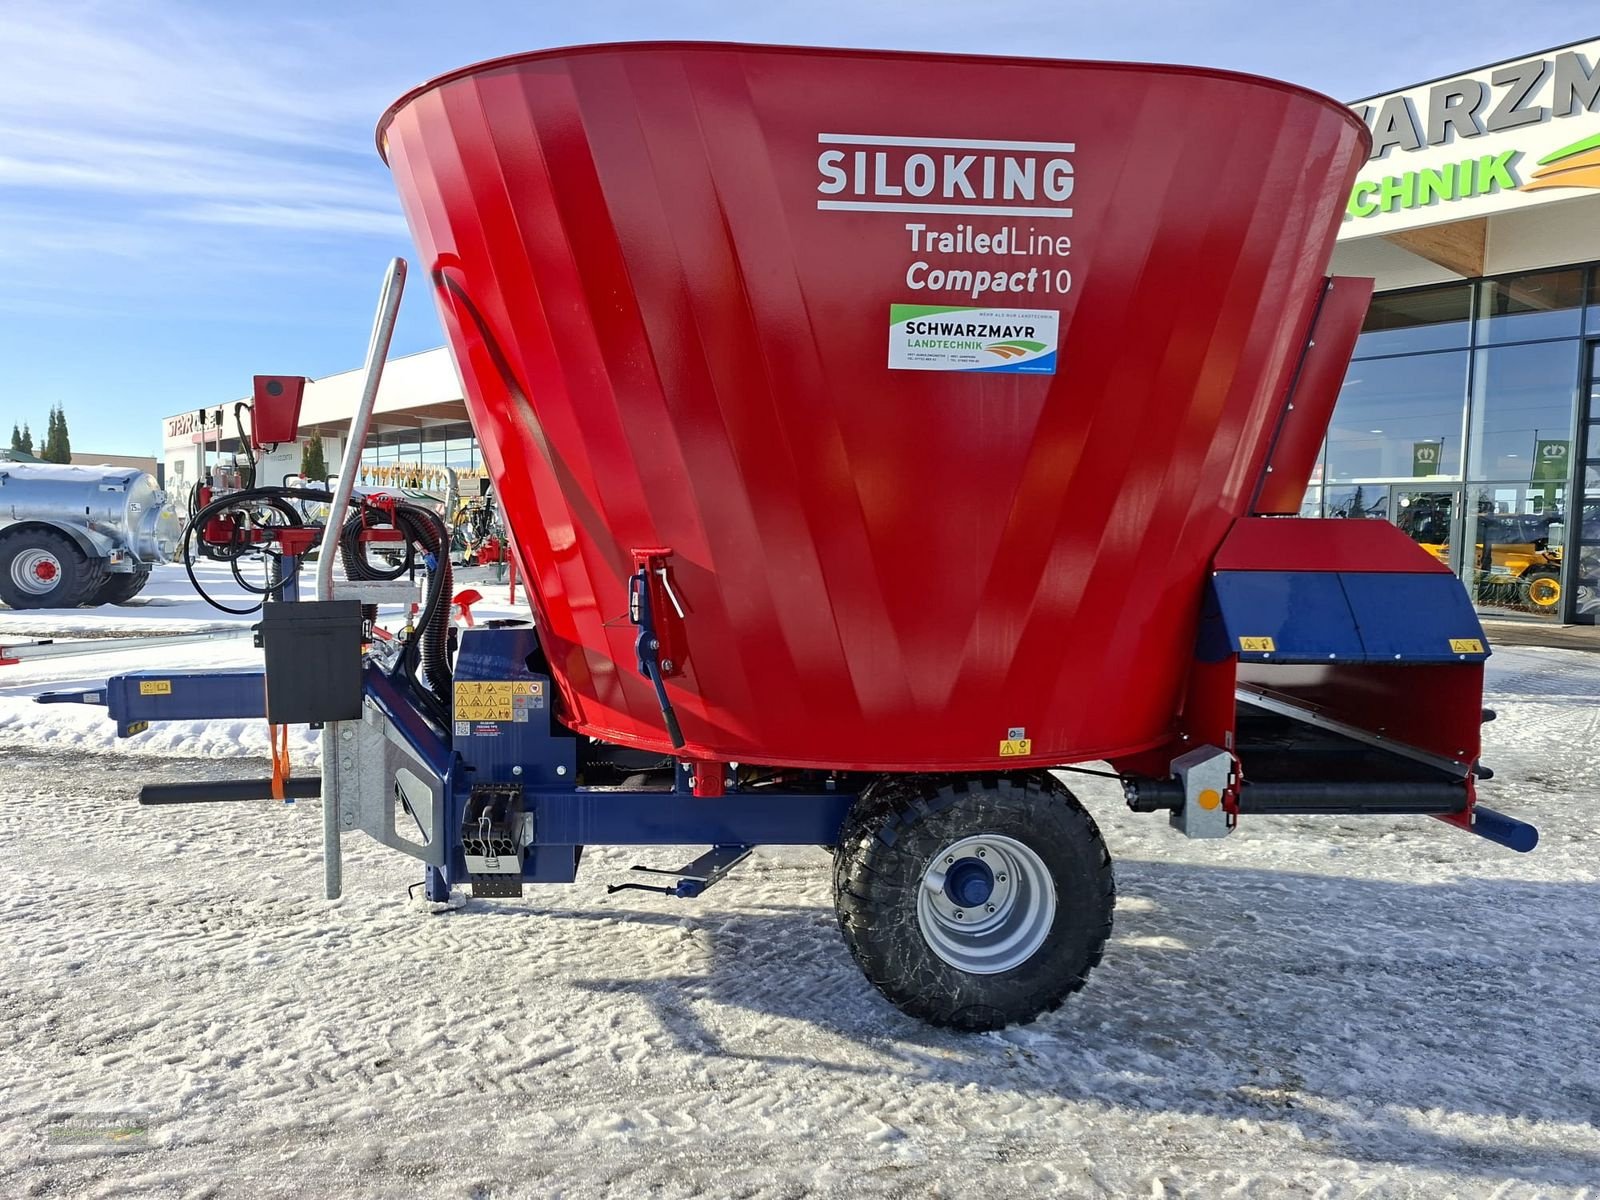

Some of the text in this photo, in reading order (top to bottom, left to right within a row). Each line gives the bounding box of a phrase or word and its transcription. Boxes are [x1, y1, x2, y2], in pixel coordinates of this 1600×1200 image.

[817, 150, 1074, 201] SILOKING
[905, 223, 1071, 256] TrailedLine
[906, 321, 1035, 338] SCHWARZMAYR
[907, 339, 982, 350] LANDTECHNIK
